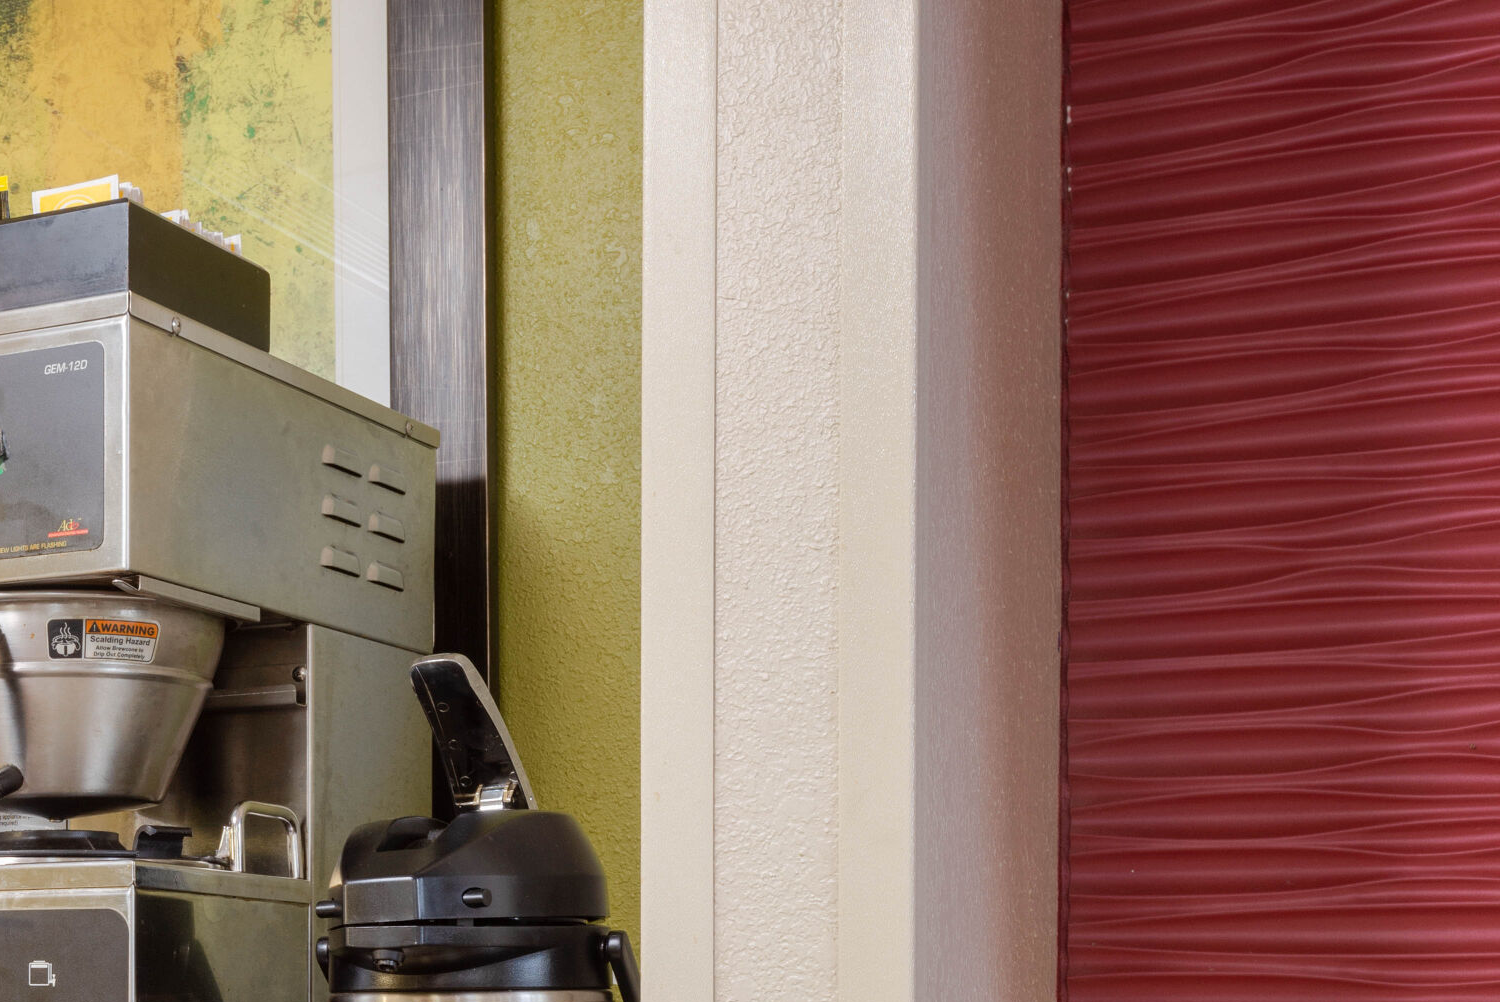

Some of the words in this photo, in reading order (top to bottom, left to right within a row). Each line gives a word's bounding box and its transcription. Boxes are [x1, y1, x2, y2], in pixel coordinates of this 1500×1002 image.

[44, 359, 88, 375] GEM-12D
[10, 544, 28, 553] LIGHTS
[40, 540, 67, 549] FLASHING
[101, 623, 155, 636] WARNING
[90, 636, 124, 645] Scalding
[125, 638, 150, 646] Hazard
